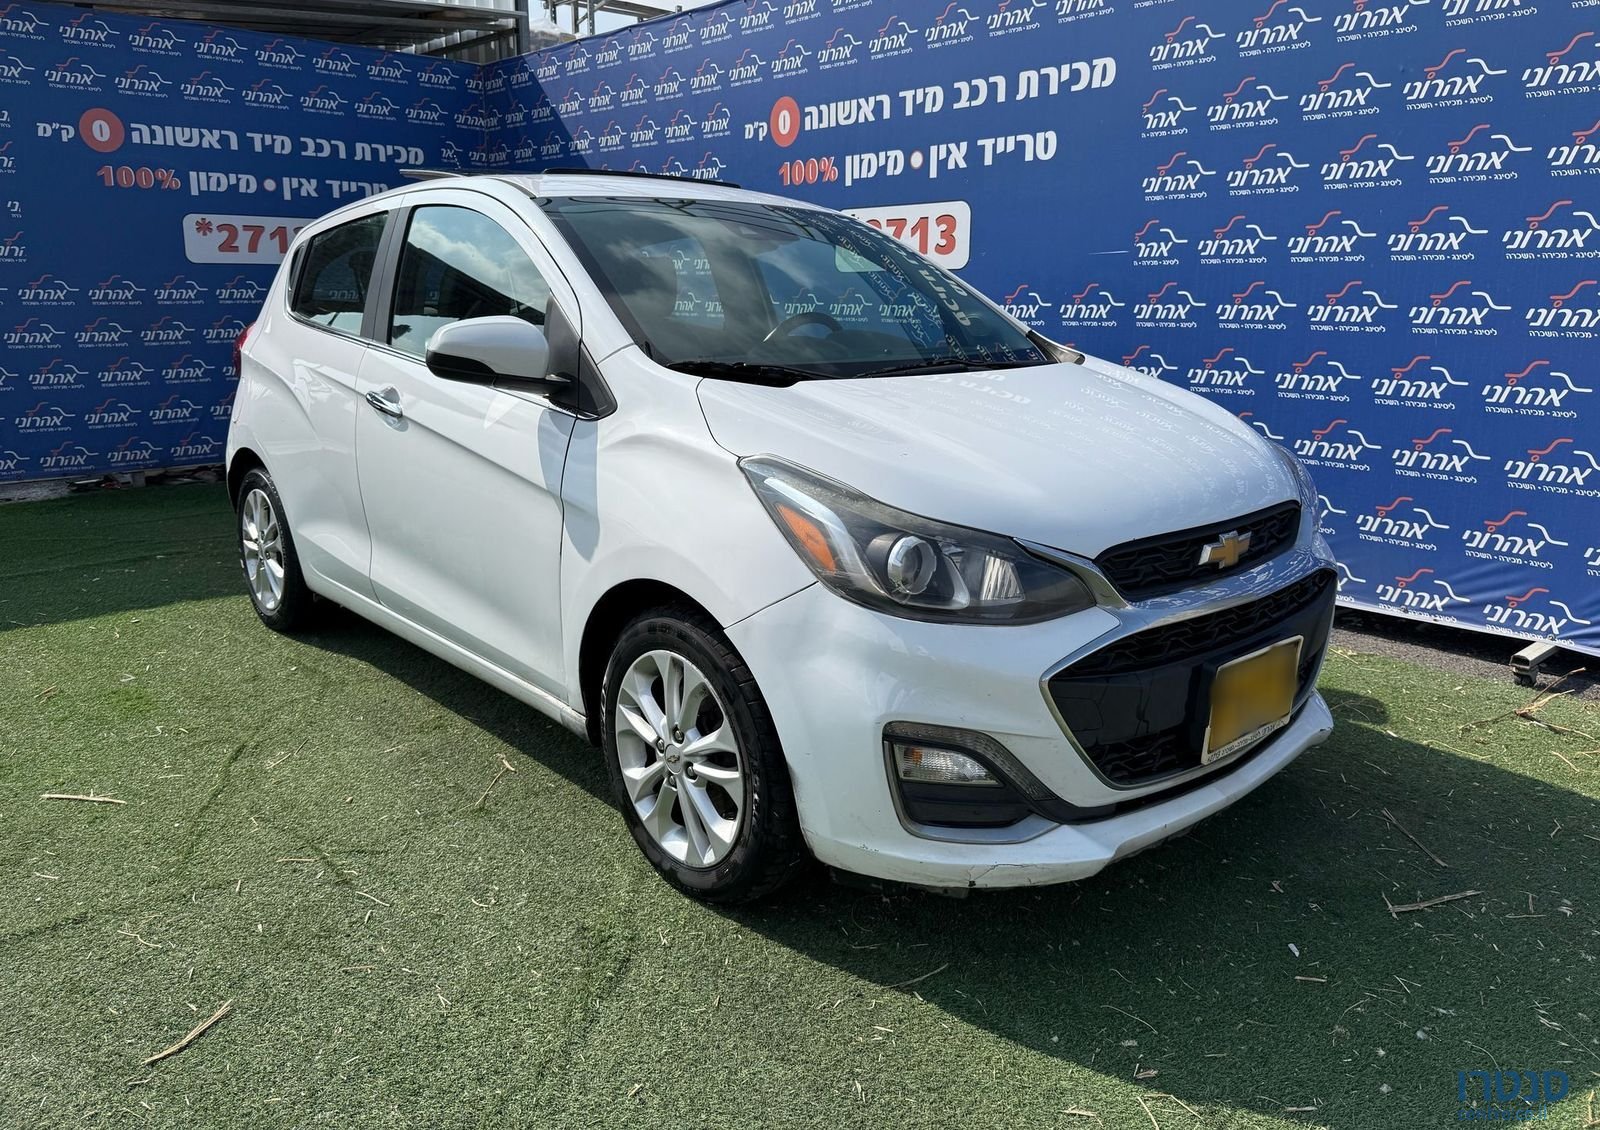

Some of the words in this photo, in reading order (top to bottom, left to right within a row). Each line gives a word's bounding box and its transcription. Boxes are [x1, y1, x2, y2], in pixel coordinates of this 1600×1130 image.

[740, 11, 770, 28] אהרוני
[987, 8, 1033, 29] אהרוני
[1334, 5, 1409, 32] אהרוני
[925, 21, 968, 42] אהרוני
[1236, 22, 1303, 48] אהרוני
[869, 33, 907, 53] אהרוני
[1151, 38, 1209, 61] אהרוני
[772, 55, 803, 72] אהרוני
[818, 45, 852, 63] אהרוני
[729, 65, 758, 81] אהרוני
[1016, 56, 1116, 100] מכירת
[954, 75, 1006, 110] רכב
[1403, 74, 1484, 100] אהרוני
[898, 85, 944, 116] מיד
[1299, 87, 1372, 111] אהרוני
[804, 94, 890, 132] ראשונה
[1207, 100, 1270, 121] אהרוני
[130, 123, 238, 150] ראשונה
[246, 132, 292, 154] מיד
[301, 136, 346, 160] רכב
[354, 142, 424, 165] מכירת
[977, 130, 1058, 166] טרייד
[844, 149, 904, 187] מימון
[929, 140, 968, 179] אין
[1320, 159, 1394, 180] אהרוני
[1426, 151, 1509, 174] אהרוני
[97, 165, 181, 190] 100%
[778, 156, 838, 187] 100%
[1226, 167, 1291, 186] אהרוני
[189, 170, 258, 196] מימון
[282, 176, 319, 200] אין
[1143, 174, 1200, 192] אהרוני
[195, 218, 302, 254] 271
[866, 213, 957, 256] 713
[1288, 236, 1357, 254] אהרוני
[1388, 232, 1466, 250] אהרוני
[1503, 229, 1592, 249] אהרוני
[1198, 239, 1260, 255] אהרוני
[1060, 304, 1111, 319] אהרוני
[1134, 304, 1190, 319] אהרוני
[1216, 304, 1280, 320] אהרוני
[1307, 305, 1378, 322] אהרוני
[1409, 306, 1489, 325] אהרוני
[1187, 368, 1248, 386] אהרוני
[1275, 373, 1342, 392] אהרוני
[1372, 378, 1448, 399] אהרוני
[1482, 384, 1569, 407] אהרוני
[1485, 406, 1513, 414] השכרה
[1520, 408, 1544, 416] מכירה
[1294, 440, 1363, 461] אהרוני
[1392, 449, 1469, 472] אהרוני
[1504, 460, 1592, 485] אהרוני
[1508, 482, 1535, 491] השכרה
[1543, 485, 1568, 494] מכירה
[1575, 489, 1600, 497] ליסינג
[1356, 514, 1429, 539] אהרוני
[1462, 530, 1545, 557] אהרוני
[1466, 550, 1492, 560] השכרה
[1499, 555, 1522, 564] מכירה
[1529, 559, 1553, 569] ליסינג
[1376, 584, 1449, 612] אהרוני
[1483, 604, 1567, 634] אהרוני
